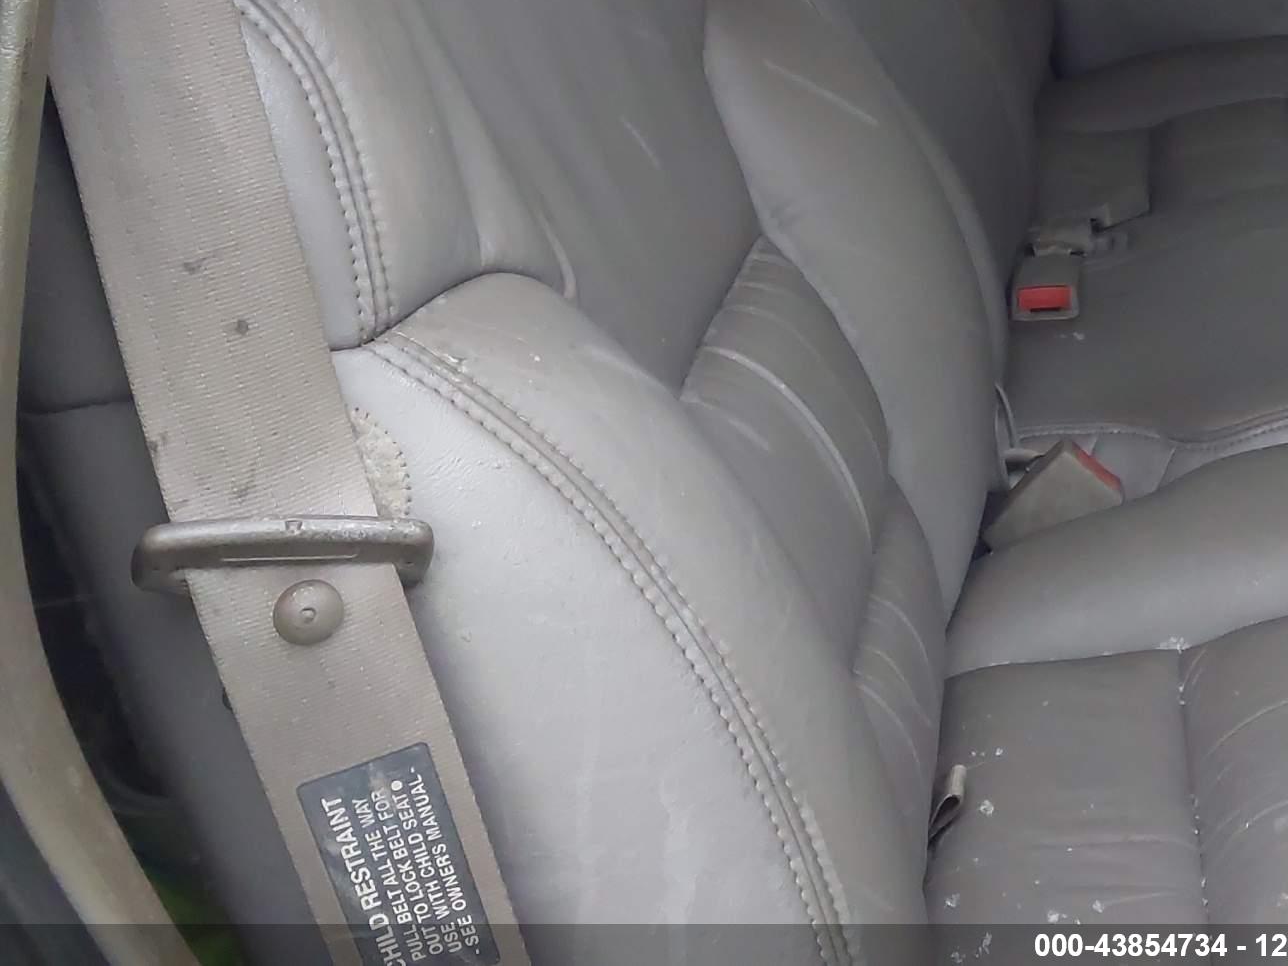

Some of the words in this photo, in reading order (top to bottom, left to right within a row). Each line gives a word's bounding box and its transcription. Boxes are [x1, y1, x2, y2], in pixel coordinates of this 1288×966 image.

[352, 798, 375, 828] WAY
[371, 787, 394, 822] FOR
[391, 793, 418, 831] SEAT
[321, 797, 382, 911] RESTRAINT
[364, 829, 388, 862] THE
[382, 823, 408, 860] BELT
[407, 831, 436, 878] CHILD
[377, 858, 399, 886] ALL
[397, 859, 424, 901] LOCK
[432, 843, 467, 912] OWNER'S
[387, 889, 413, 925] BELT
[413, 901, 432, 925] TO
[424, 879, 450, 921] WITH
[369, 912, 406, 966] CHILD
[403, 924, 427, 962] PULL
[421, 925, 444, 955] OUT
[440, 921, 463, 953] USE
